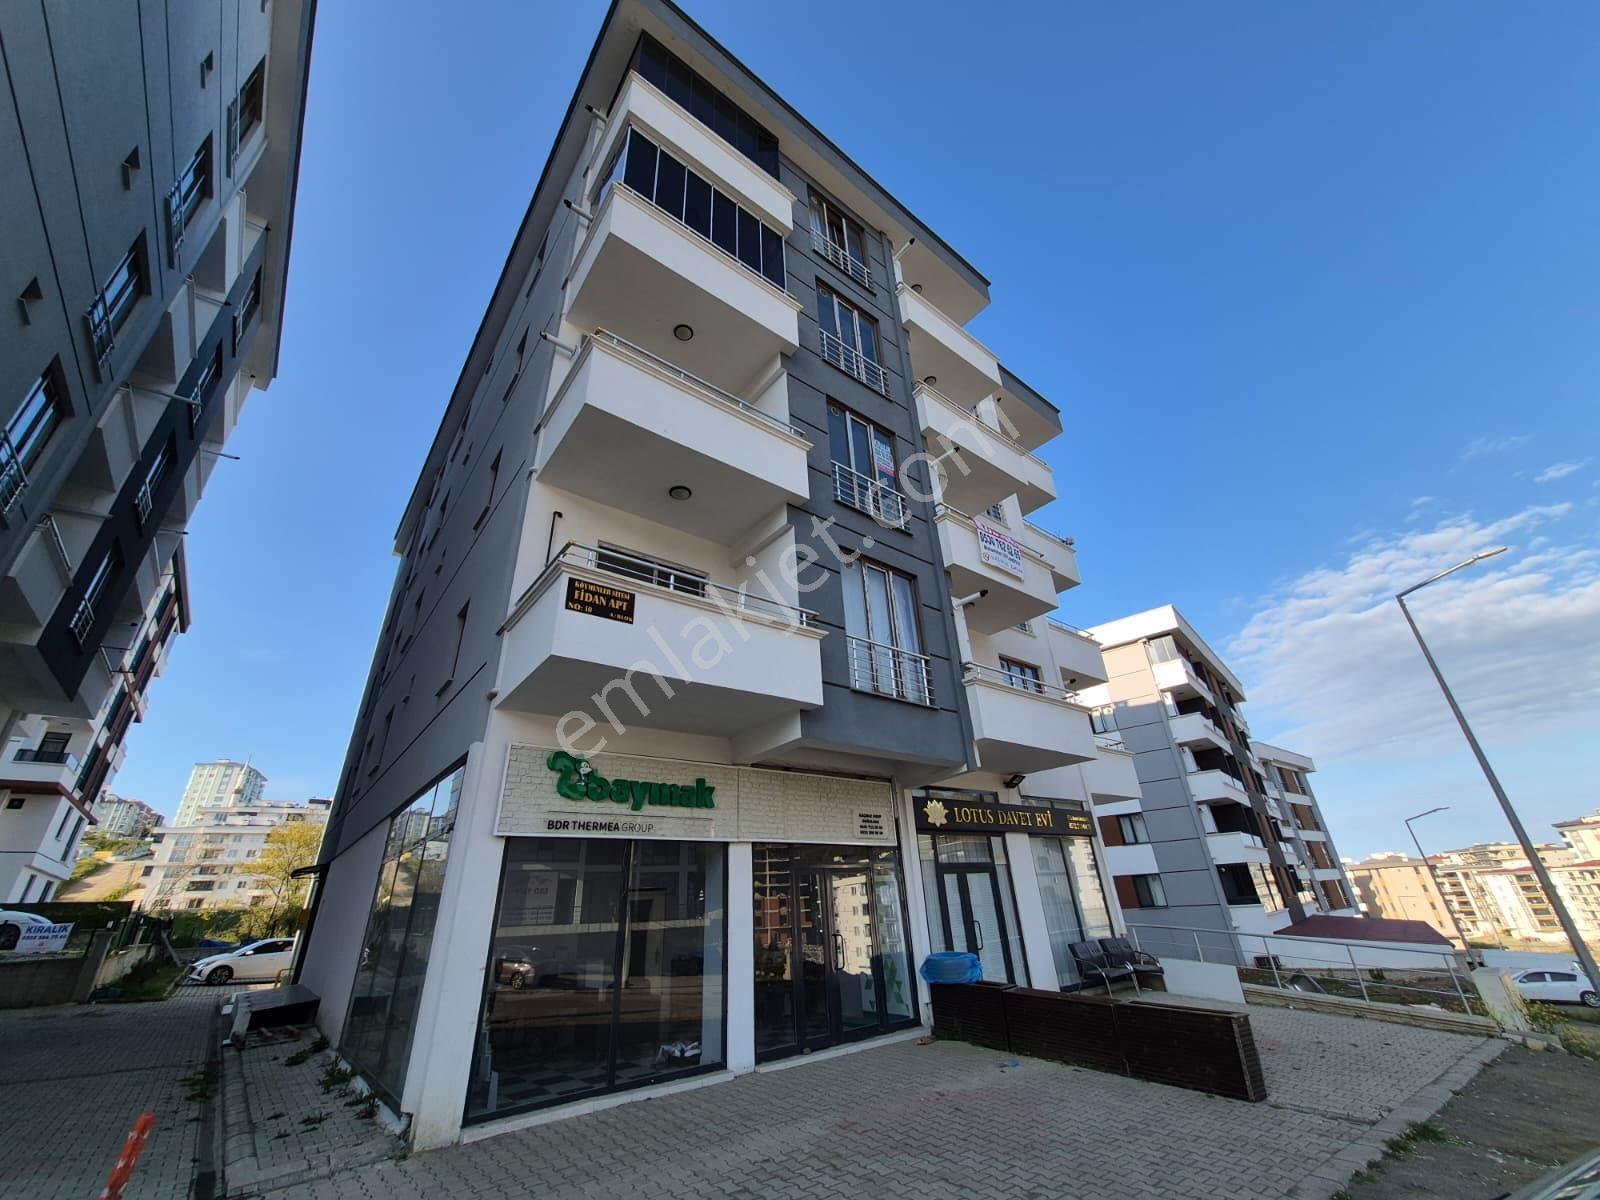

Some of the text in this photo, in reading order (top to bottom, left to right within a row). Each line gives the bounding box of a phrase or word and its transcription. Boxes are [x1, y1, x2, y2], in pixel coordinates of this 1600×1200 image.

[574, 589, 607, 606] FİDAN
[580, 766, 716, 811] baymak
[547, 820, 654, 833] BDR THERMEA GROUP
[954, 807, 994, 824] LOTUS
[998, 810, 1032, 827] DAVET
[1035, 810, 1053, 828] EVİ
